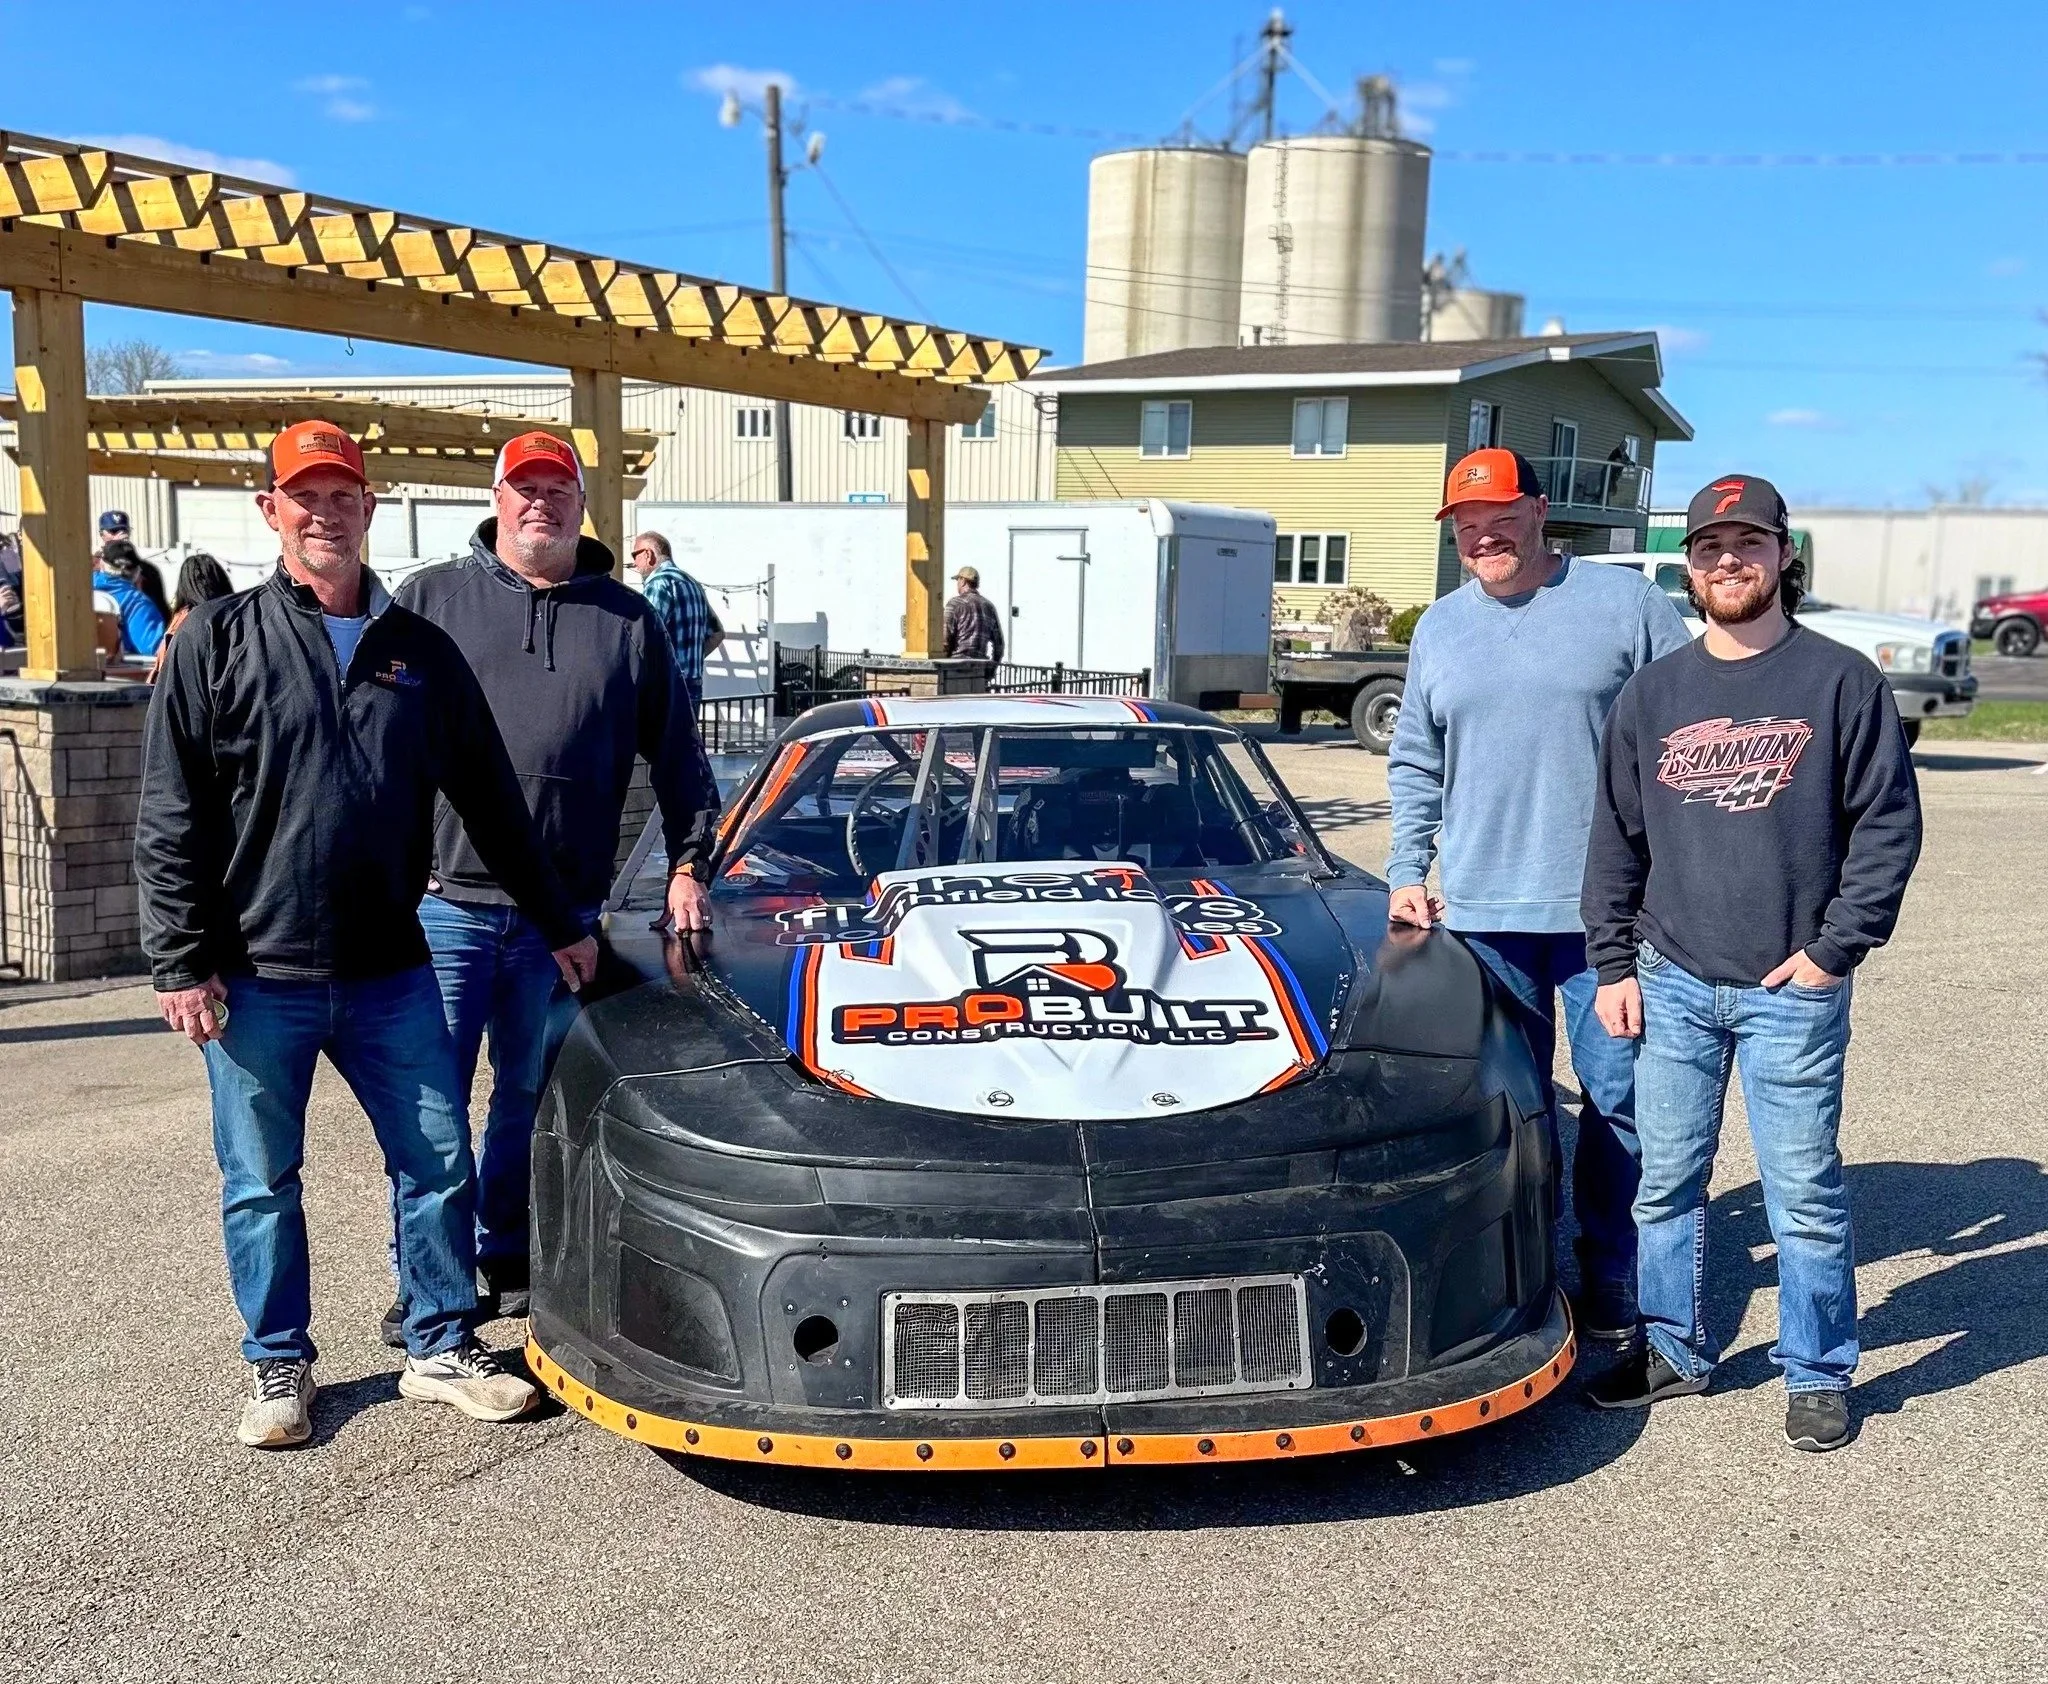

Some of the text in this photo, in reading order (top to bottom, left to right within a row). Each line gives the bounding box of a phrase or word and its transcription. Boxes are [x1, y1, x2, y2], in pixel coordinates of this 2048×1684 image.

[843, 994, 1258, 1031] PROBUILT
[887, 1022, 1227, 1042] CONSTRUCTION LLC
